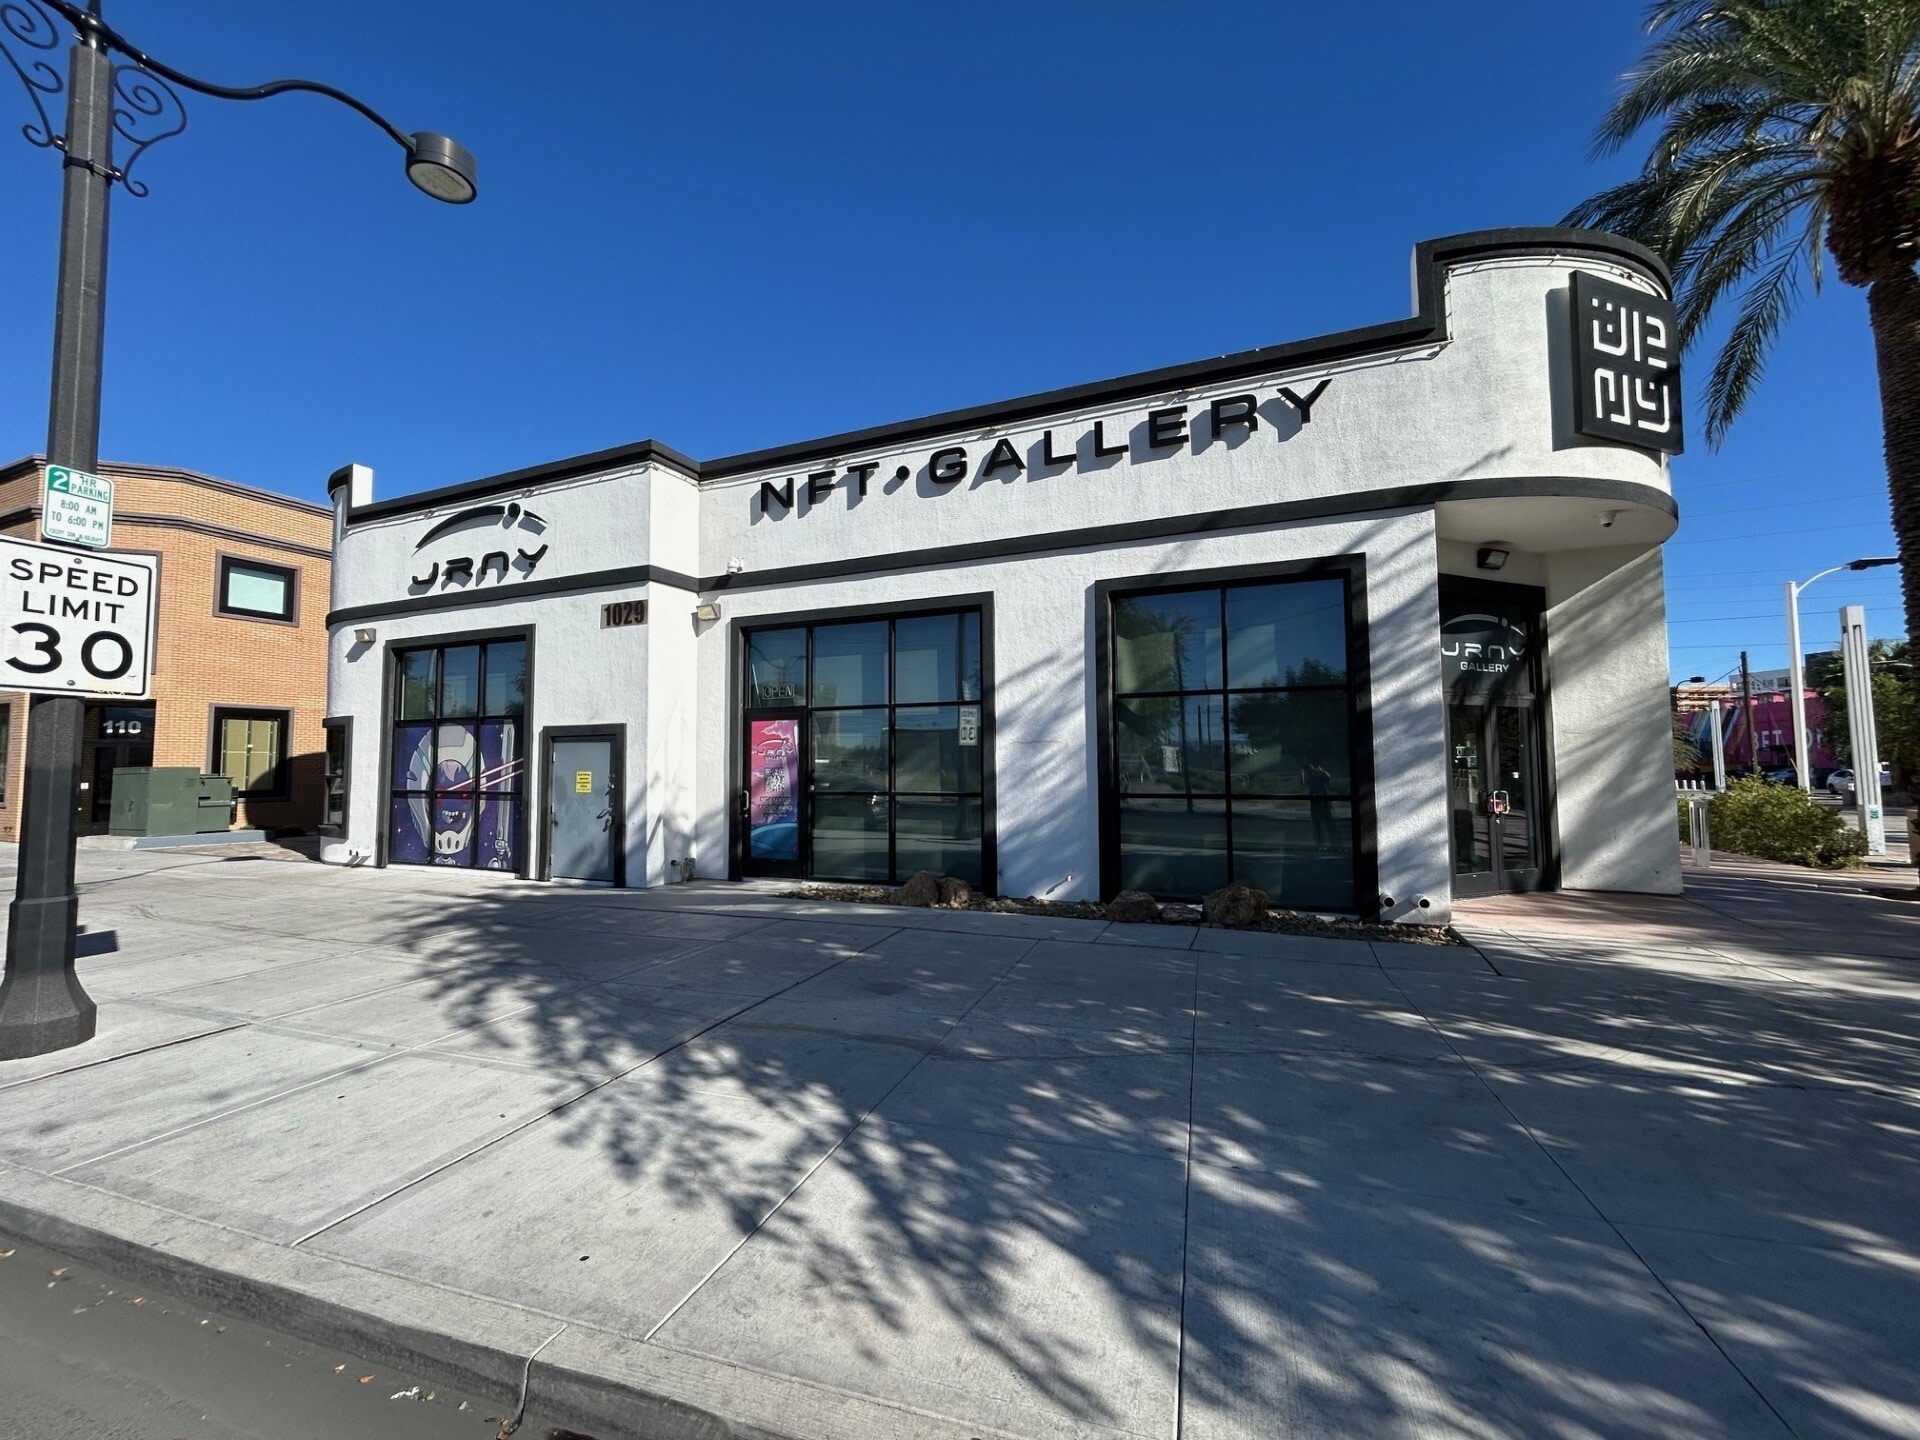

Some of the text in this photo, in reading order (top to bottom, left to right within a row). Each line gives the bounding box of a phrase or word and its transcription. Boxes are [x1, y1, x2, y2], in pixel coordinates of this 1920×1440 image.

[760, 378, 1333, 513] NFT GALLERY
[53, 471, 97, 491] 2 HR
[71, 483, 108, 501] PARKING
[60, 499, 97, 515] 8:00 AM
[51, 511, 104, 531] TO 6:00 PM
[9, 558, 139, 597] SPEED
[22, 590, 125, 624] LIMIT
[604, 600, 645, 627] 1029
[5, 622, 133, 680] 30
[1460, 661, 1510, 673] GALLERY
[764, 685, 793, 698] OPEN
[103, 720, 142, 734] 110
